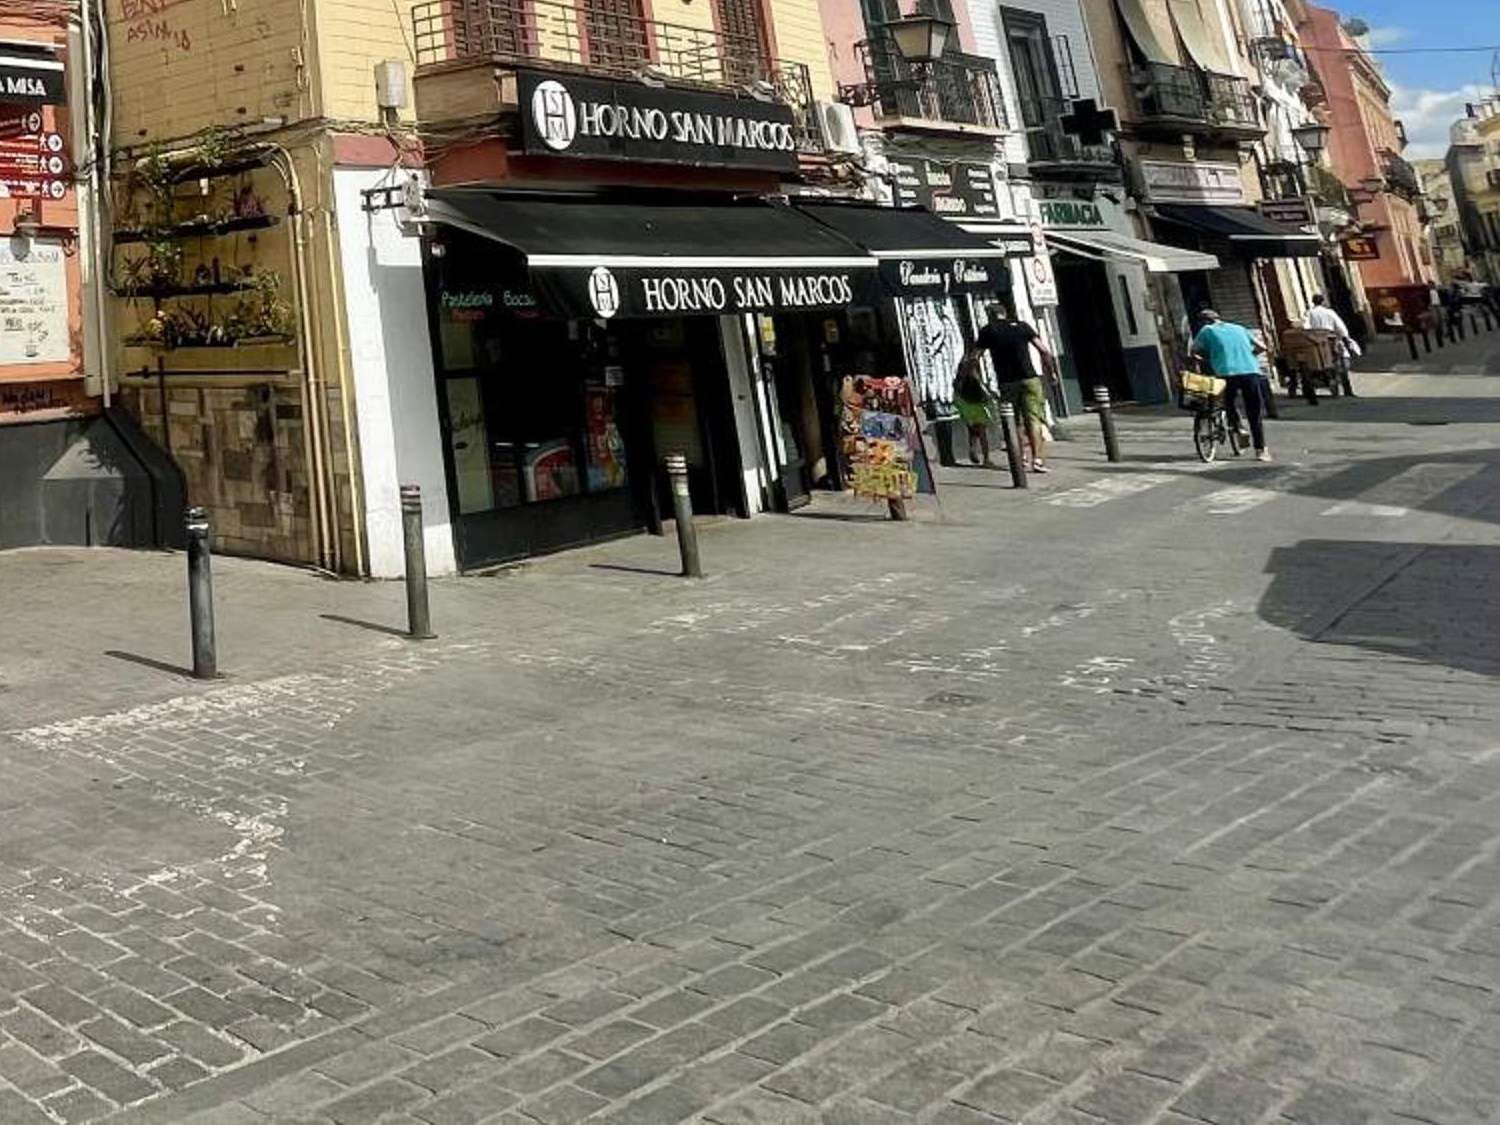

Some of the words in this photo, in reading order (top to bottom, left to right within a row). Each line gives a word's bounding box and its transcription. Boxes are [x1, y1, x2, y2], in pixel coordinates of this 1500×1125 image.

[7, 77, 47, 97] MISA
[580, 102, 667, 140] HORNO
[671, 112, 714, 144] SAN
[717, 117, 795, 151] MARCOS
[1038, 203, 1103, 225] FARMACIA
[642, 278, 726, 310] HORNO
[733, 277, 773, 307] SAN
[779, 275, 852, 306] MARCOS
